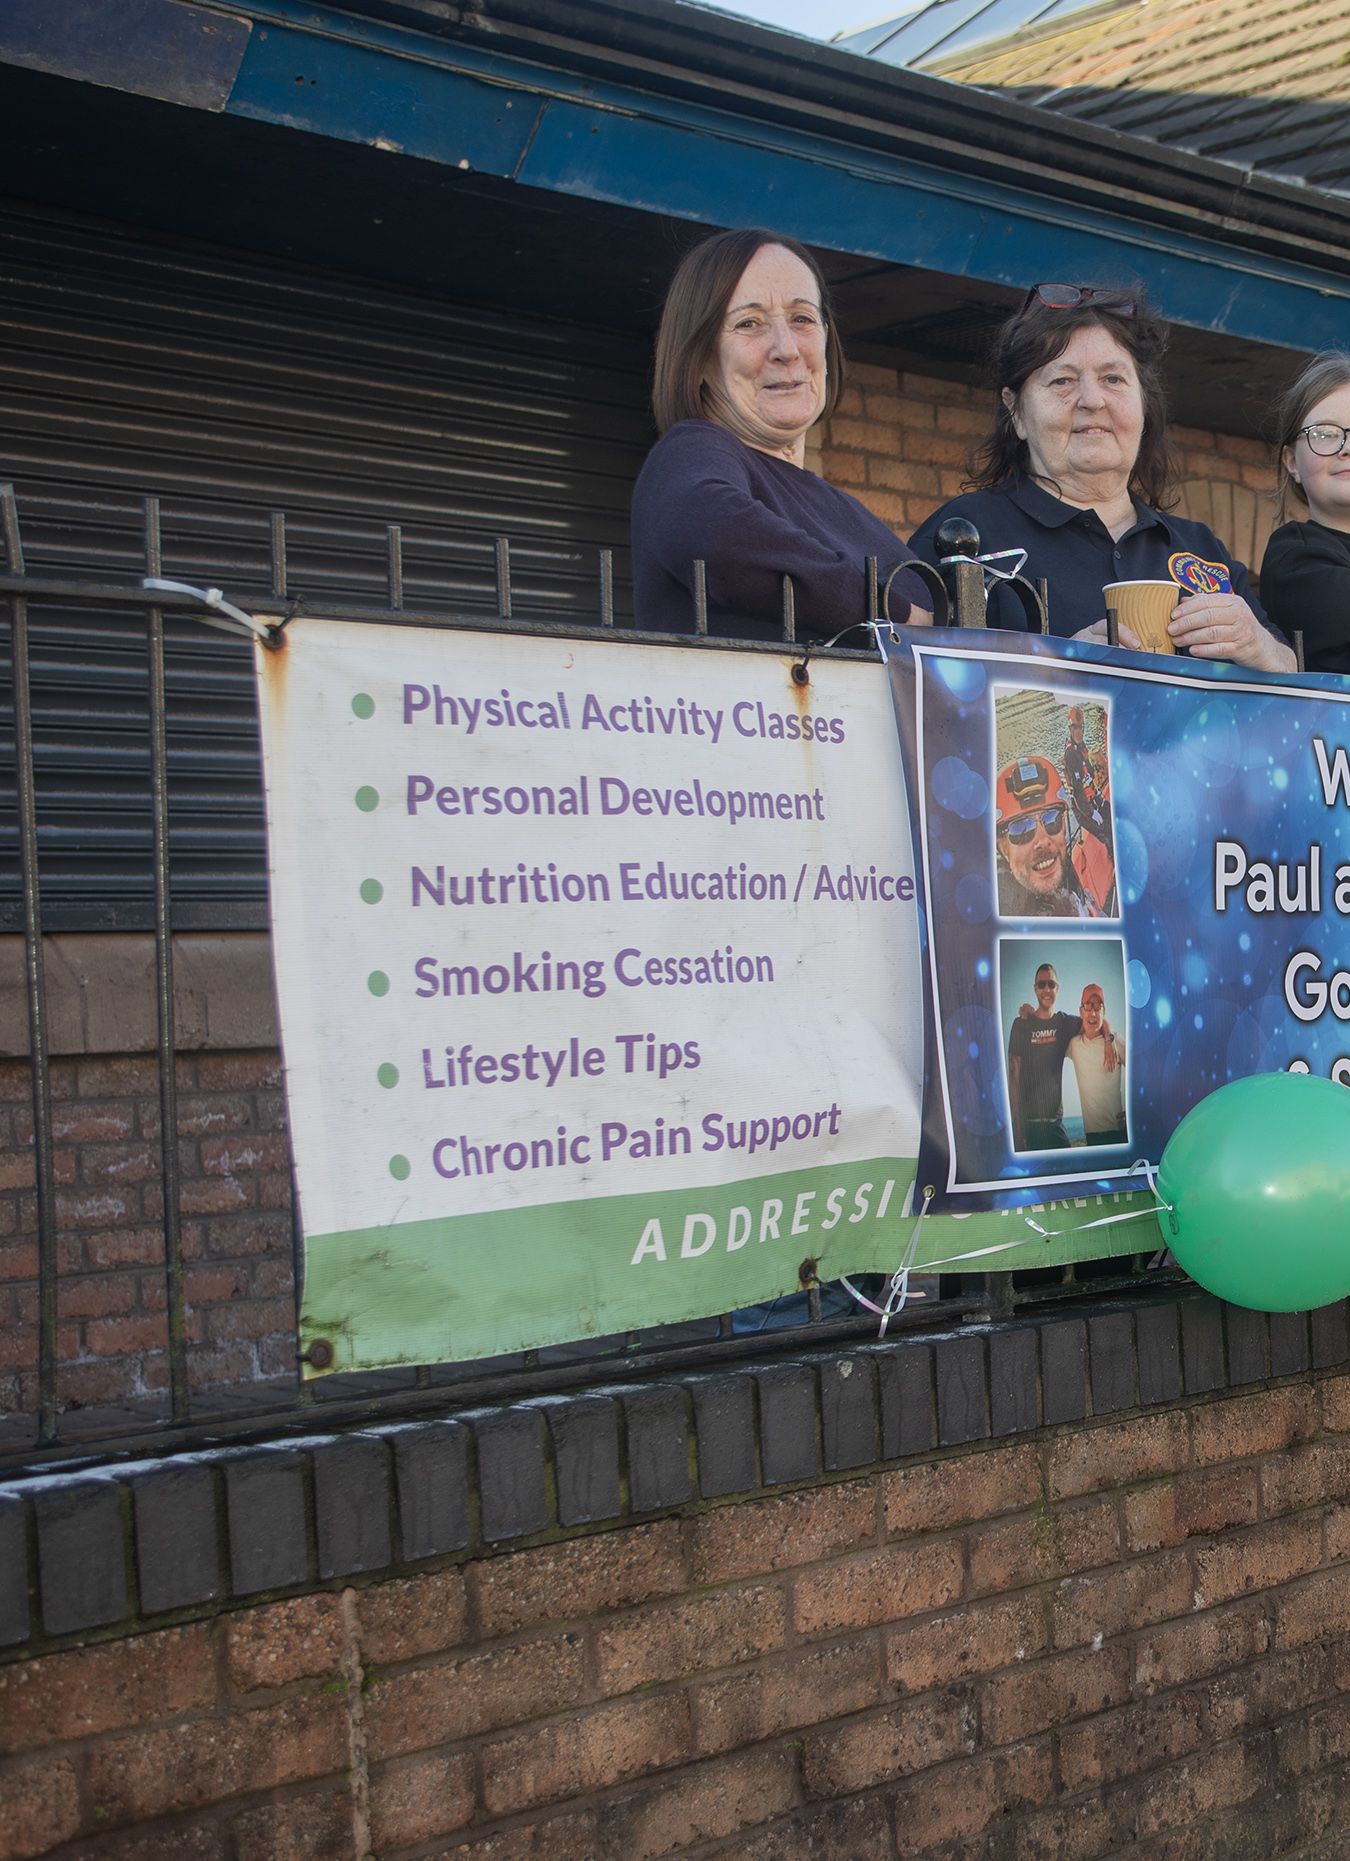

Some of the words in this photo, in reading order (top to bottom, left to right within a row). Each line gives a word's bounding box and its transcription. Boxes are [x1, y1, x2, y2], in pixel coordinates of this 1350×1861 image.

[403, 684, 571, 734] Physical
[581, 691, 724, 743] Activity
[732, 702, 846, 744] Classes
[406, 775, 590, 815] Personal
[600, 777, 825, 825] Development
[411, 864, 610, 907] Nutrition
[619, 861, 787, 902] Education
[793, 863, 807, 903] /
[813, 863, 914, 902] Advice
[1214, 841, 1321, 913] Paul
[414, 950, 607, 998] Smoking
[613, 945, 774, 988] Cessation
[422, 1035, 606, 1090] Lifestyle
[615, 1034, 702, 1078] Tips
[431, 1122, 592, 1181] Chronic
[600, 1118, 693, 1164] Pain
[701, 1101, 842, 1155] Support
